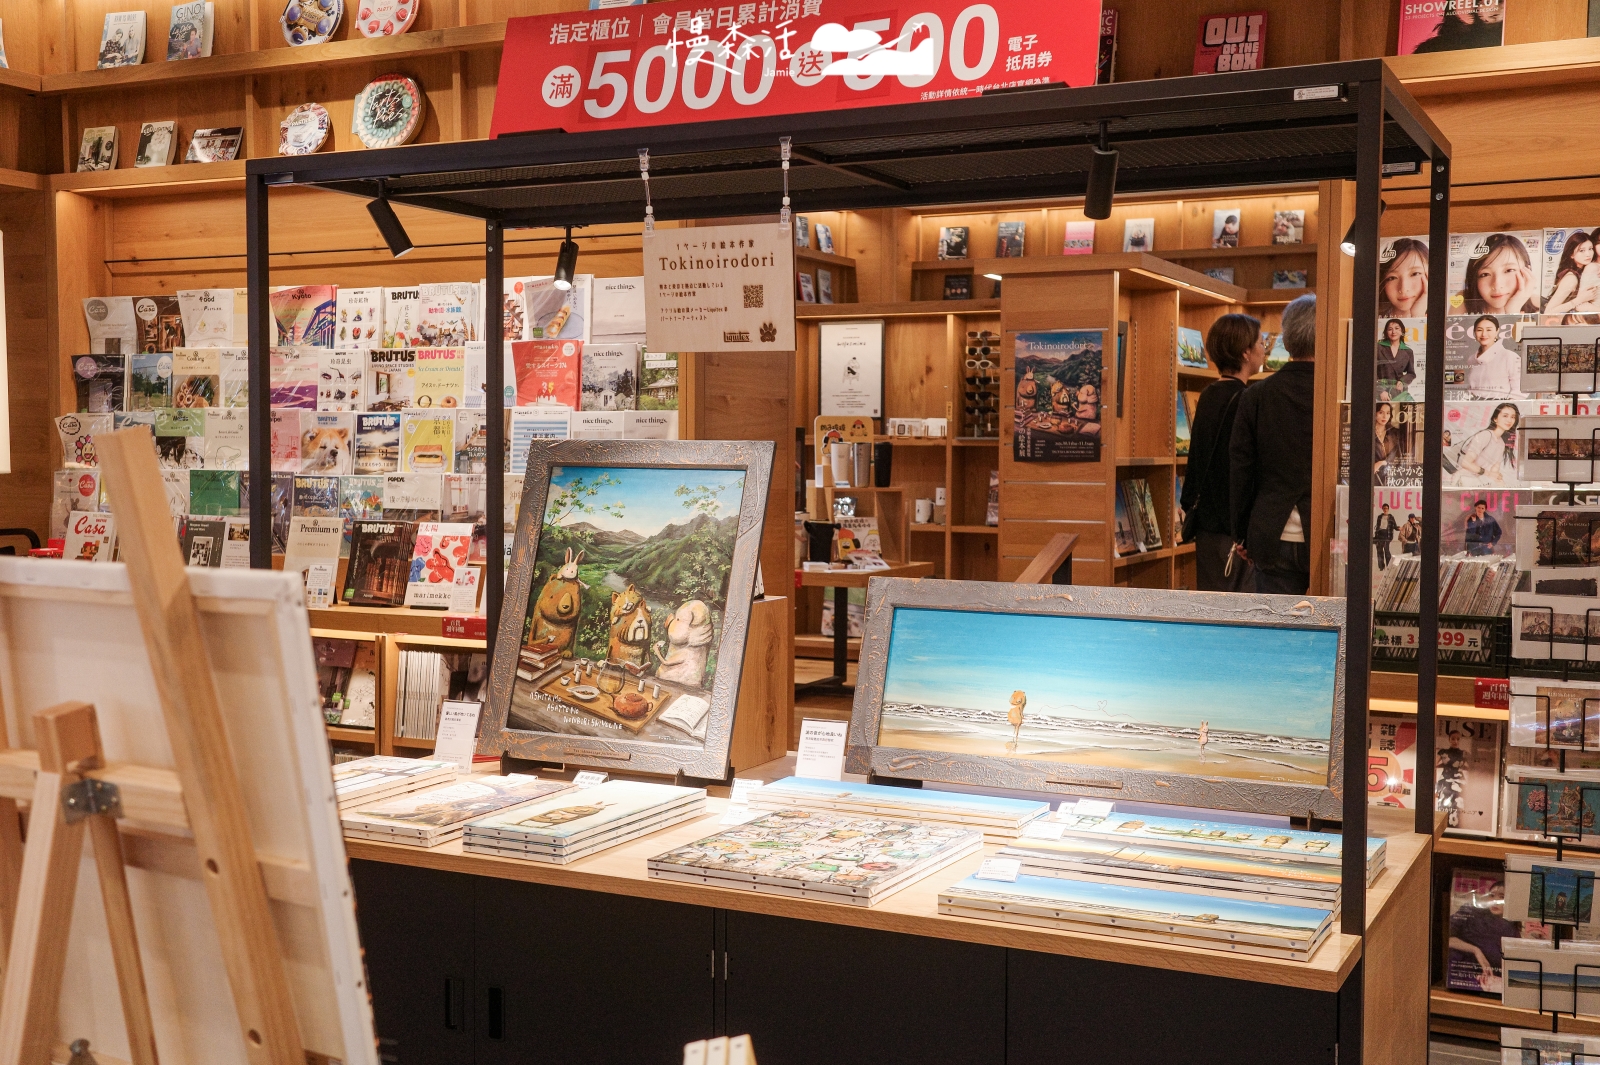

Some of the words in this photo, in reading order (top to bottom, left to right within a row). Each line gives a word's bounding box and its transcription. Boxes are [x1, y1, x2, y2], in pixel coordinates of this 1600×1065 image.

[176, 4, 202, 19] GINO
[550, 17, 630, 45] 指定櫃位
[1204, 15, 1263, 46] OUT
[1007, 34, 1039, 52] 電子
[1222, 44, 1237, 54] OF
[1238, 42, 1259, 53] THE
[1005, 50, 1053, 72] 抵用券
[1217, 52, 1258, 71] BOX
[549, 72, 575, 100] 滿
[583, 34, 777, 118] 5000
[797, 50, 824, 78] 送
[369, 89, 402, 115] Tarts
[659, 252, 774, 270] Tokinoirodori
[618, 283, 636, 291] things.
[391, 291, 420, 300] BRUTU
[138, 305, 155, 313] Casa
[724, 331, 750, 342] Liquitex
[371, 350, 416, 362] BRUTUS
[418, 349, 456, 359] BRUTUS
[362, 415, 396, 427] BRUTUS
[75, 515, 107, 535] Casa
[300, 524, 330, 533] Premium
[362, 523, 396, 534] BRUTUS
[1467, 637, 1479, 648] 元
